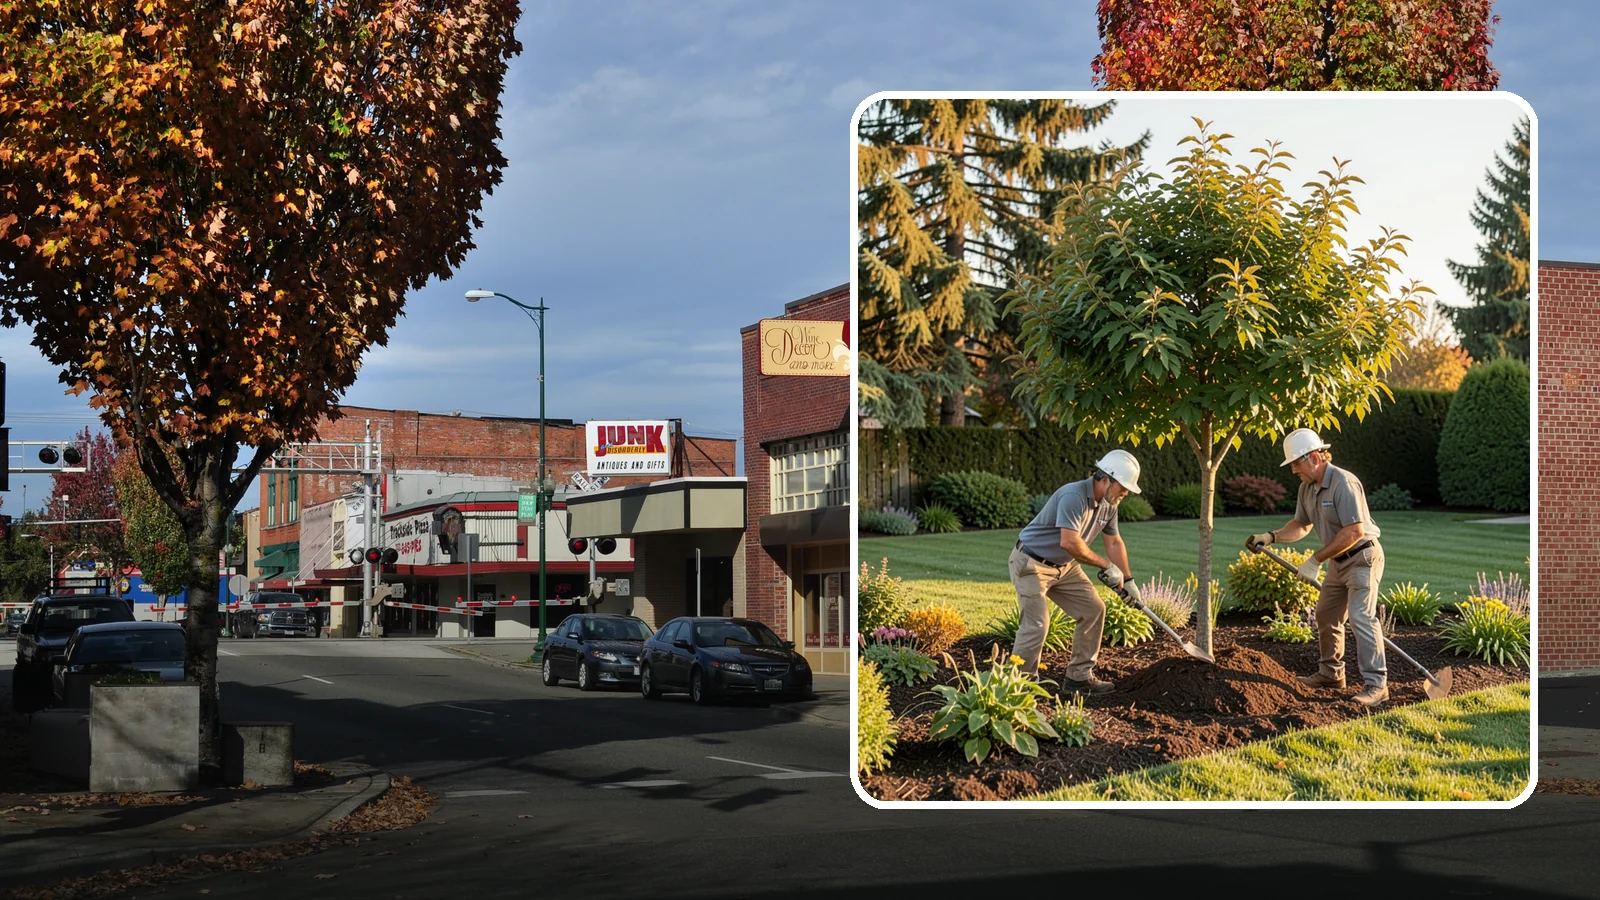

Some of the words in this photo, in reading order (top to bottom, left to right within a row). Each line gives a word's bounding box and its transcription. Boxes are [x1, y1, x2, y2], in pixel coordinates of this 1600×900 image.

[596, 425, 665, 457] JUNK
[607, 446, 646, 454] DISORDERLY
[597, 461, 628, 470] ANTIQUES
[631, 461, 644, 470] AND
[646, 460, 665, 469] GIFTS
[573, 473, 588, 490] RAIL
[390, 521, 413, 539] Trackside
[415, 519, 429, 535] Pizza
